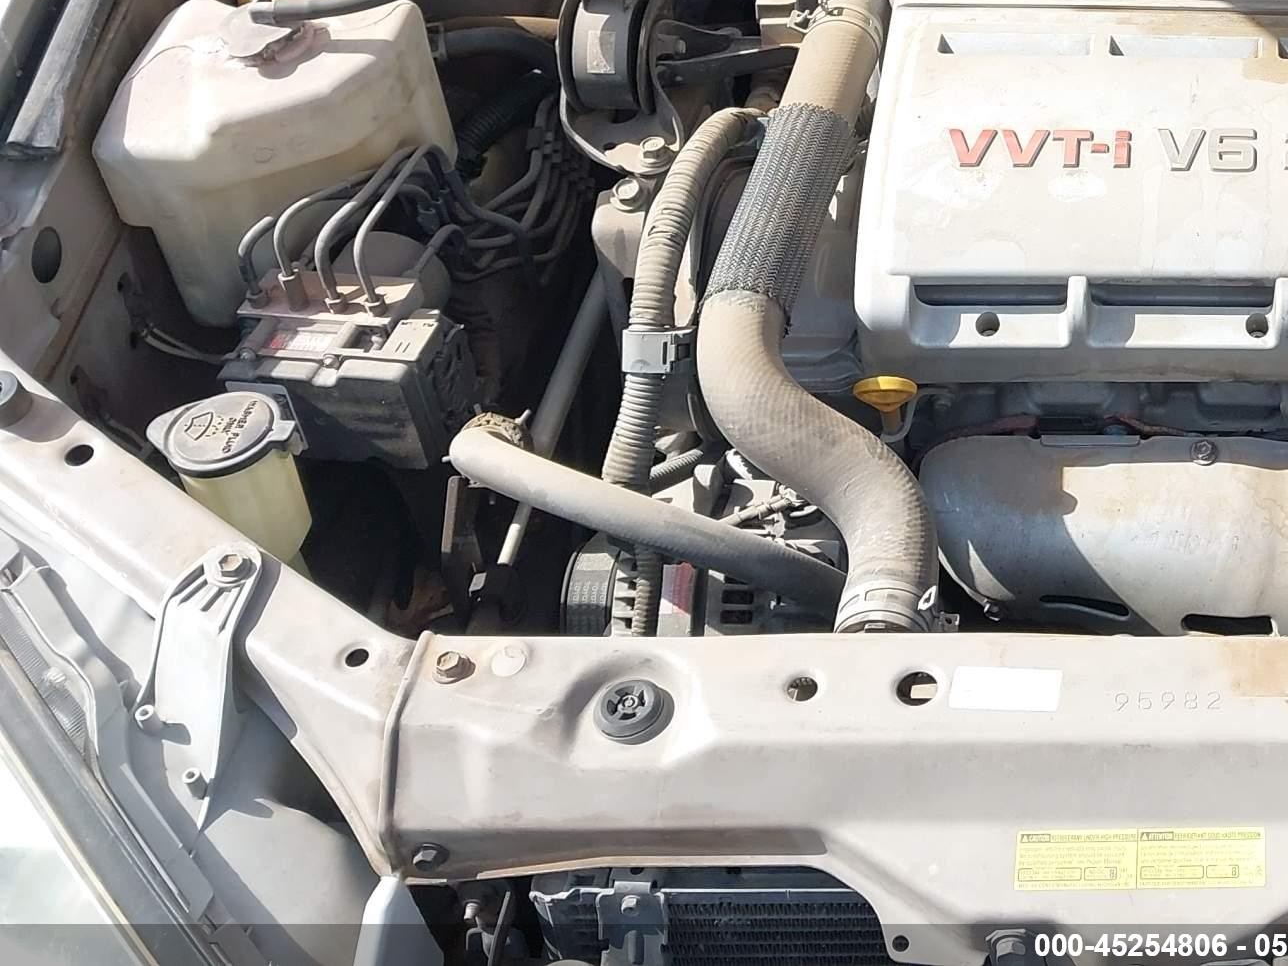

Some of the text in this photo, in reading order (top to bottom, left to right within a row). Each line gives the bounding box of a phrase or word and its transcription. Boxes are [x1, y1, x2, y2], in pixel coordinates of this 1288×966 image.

[949, 129, 1132, 168] VVT-i
[1158, 128, 1257, 172] V6
[1114, 691, 1222, 712] 95982
